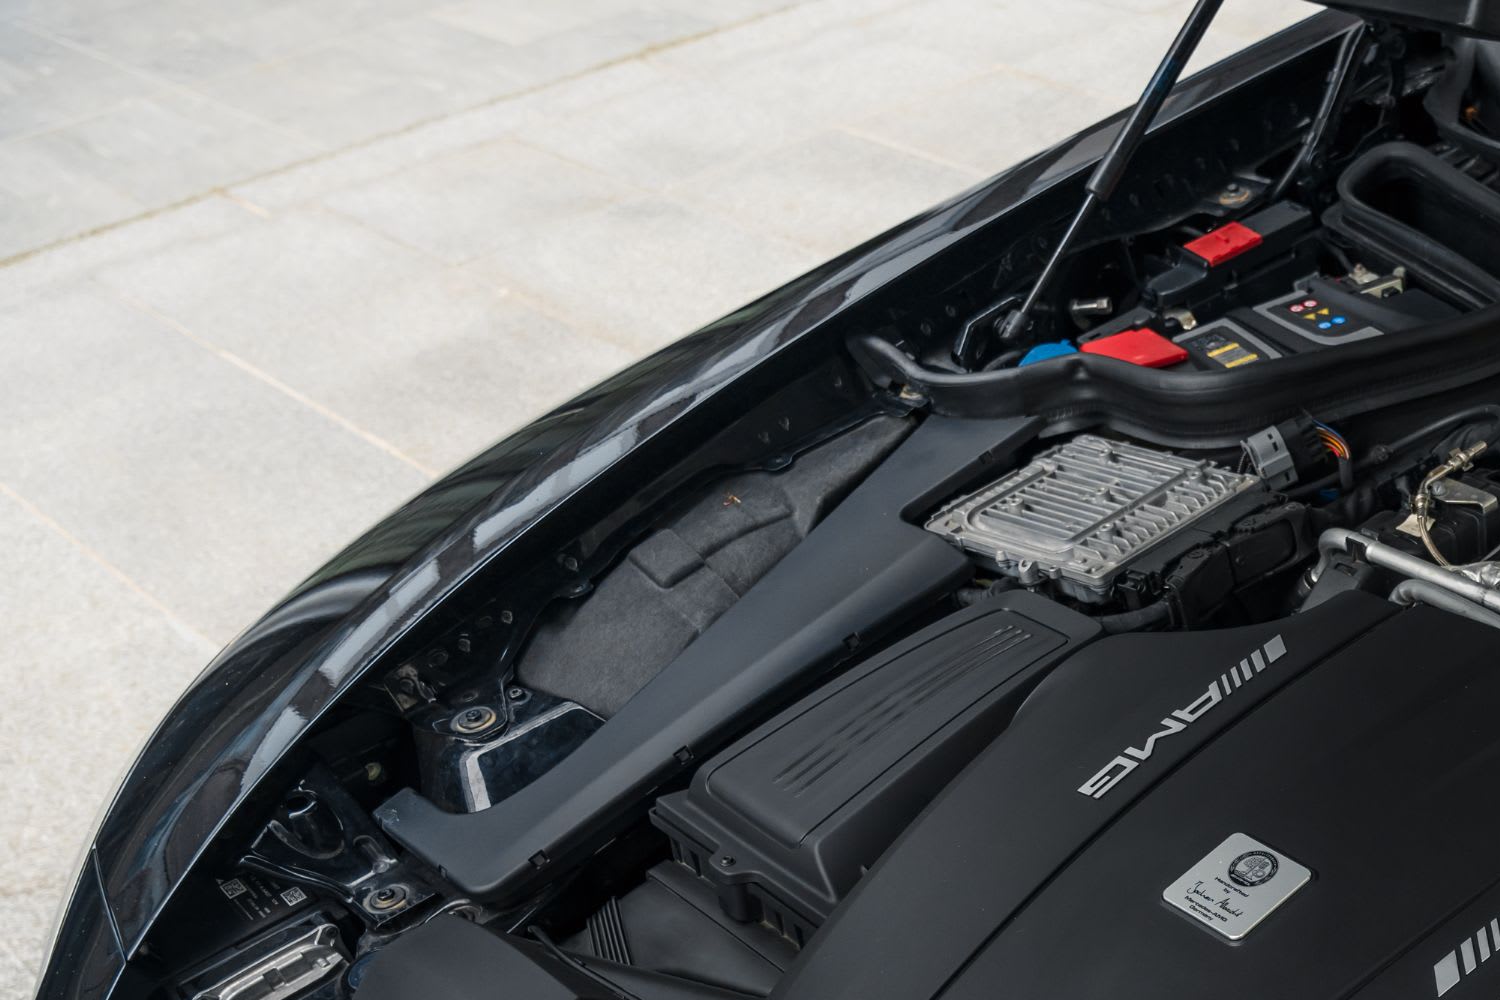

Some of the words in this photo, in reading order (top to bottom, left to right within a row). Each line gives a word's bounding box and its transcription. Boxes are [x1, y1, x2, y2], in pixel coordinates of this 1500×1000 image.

[1077, 681, 1223, 799] AMG
[1215, 877, 1250, 897] Handcrafted
[1185, 896, 1228, 922] Mercedes-AMG
[1189, 905, 1214, 921] Germany
